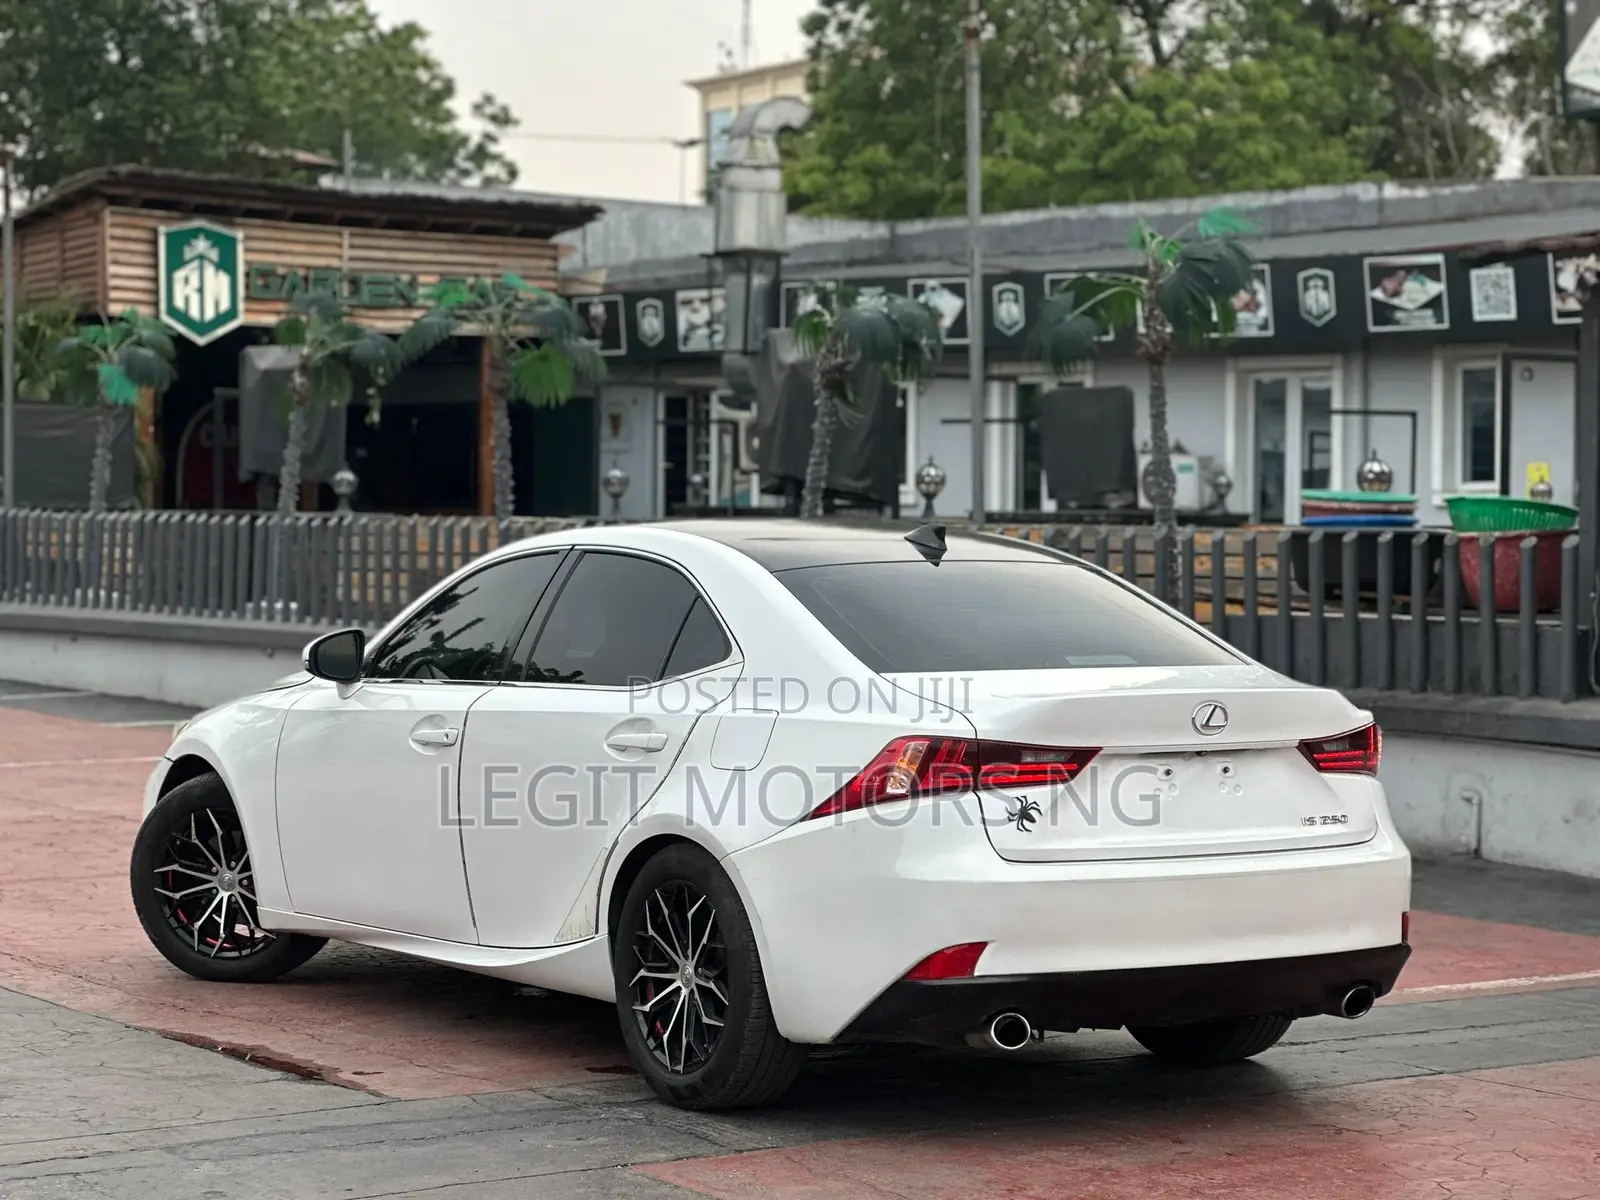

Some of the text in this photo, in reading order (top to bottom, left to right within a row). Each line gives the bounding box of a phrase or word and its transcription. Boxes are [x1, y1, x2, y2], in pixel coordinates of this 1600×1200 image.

[172, 259, 231, 323] RM
[1300, 813, 1349, 827] IS 250
